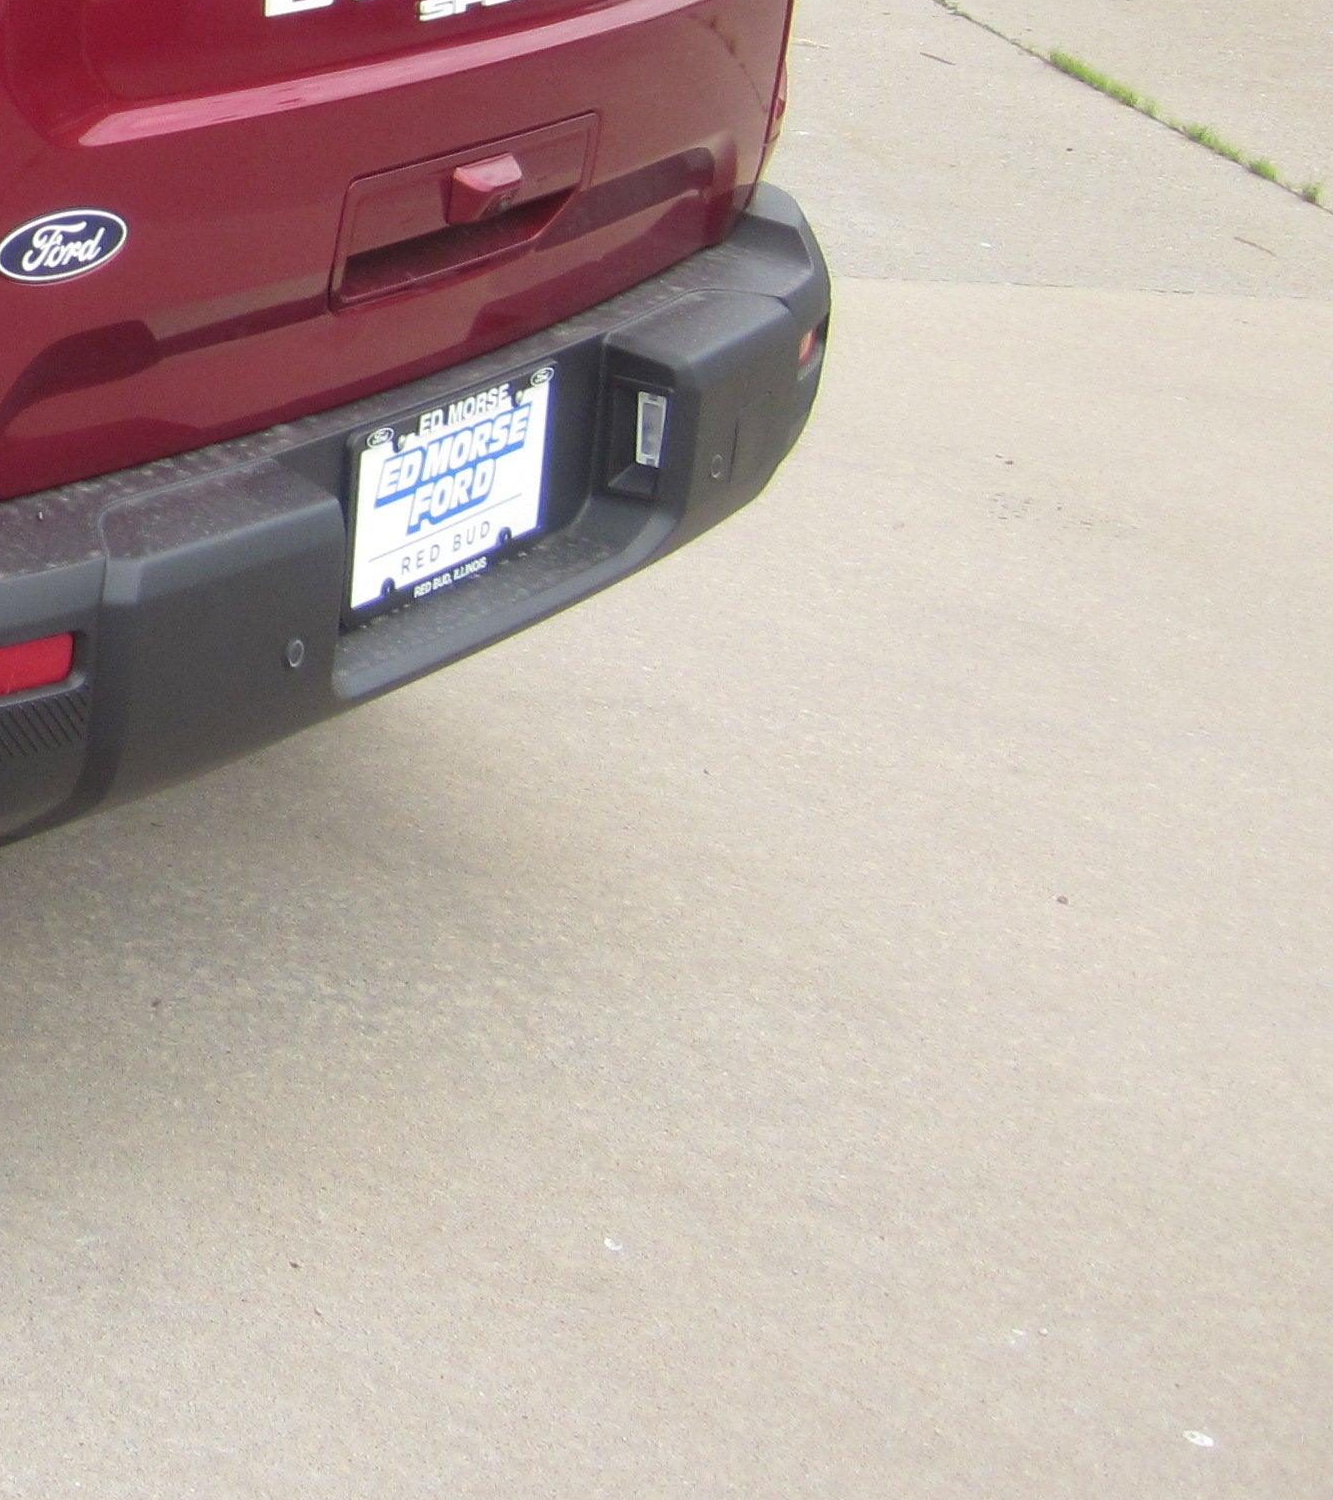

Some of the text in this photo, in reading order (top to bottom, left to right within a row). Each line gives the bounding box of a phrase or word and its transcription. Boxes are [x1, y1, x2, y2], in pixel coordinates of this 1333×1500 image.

[21, 221, 105, 272] Ford
[419, 383, 511, 436] ED MORSE
[375, 404, 531, 507] ED MORSE
[406, 459, 496, 535] FORD
[401, 521, 490, 575] RED BUD
[413, 581, 432, 599] RED
